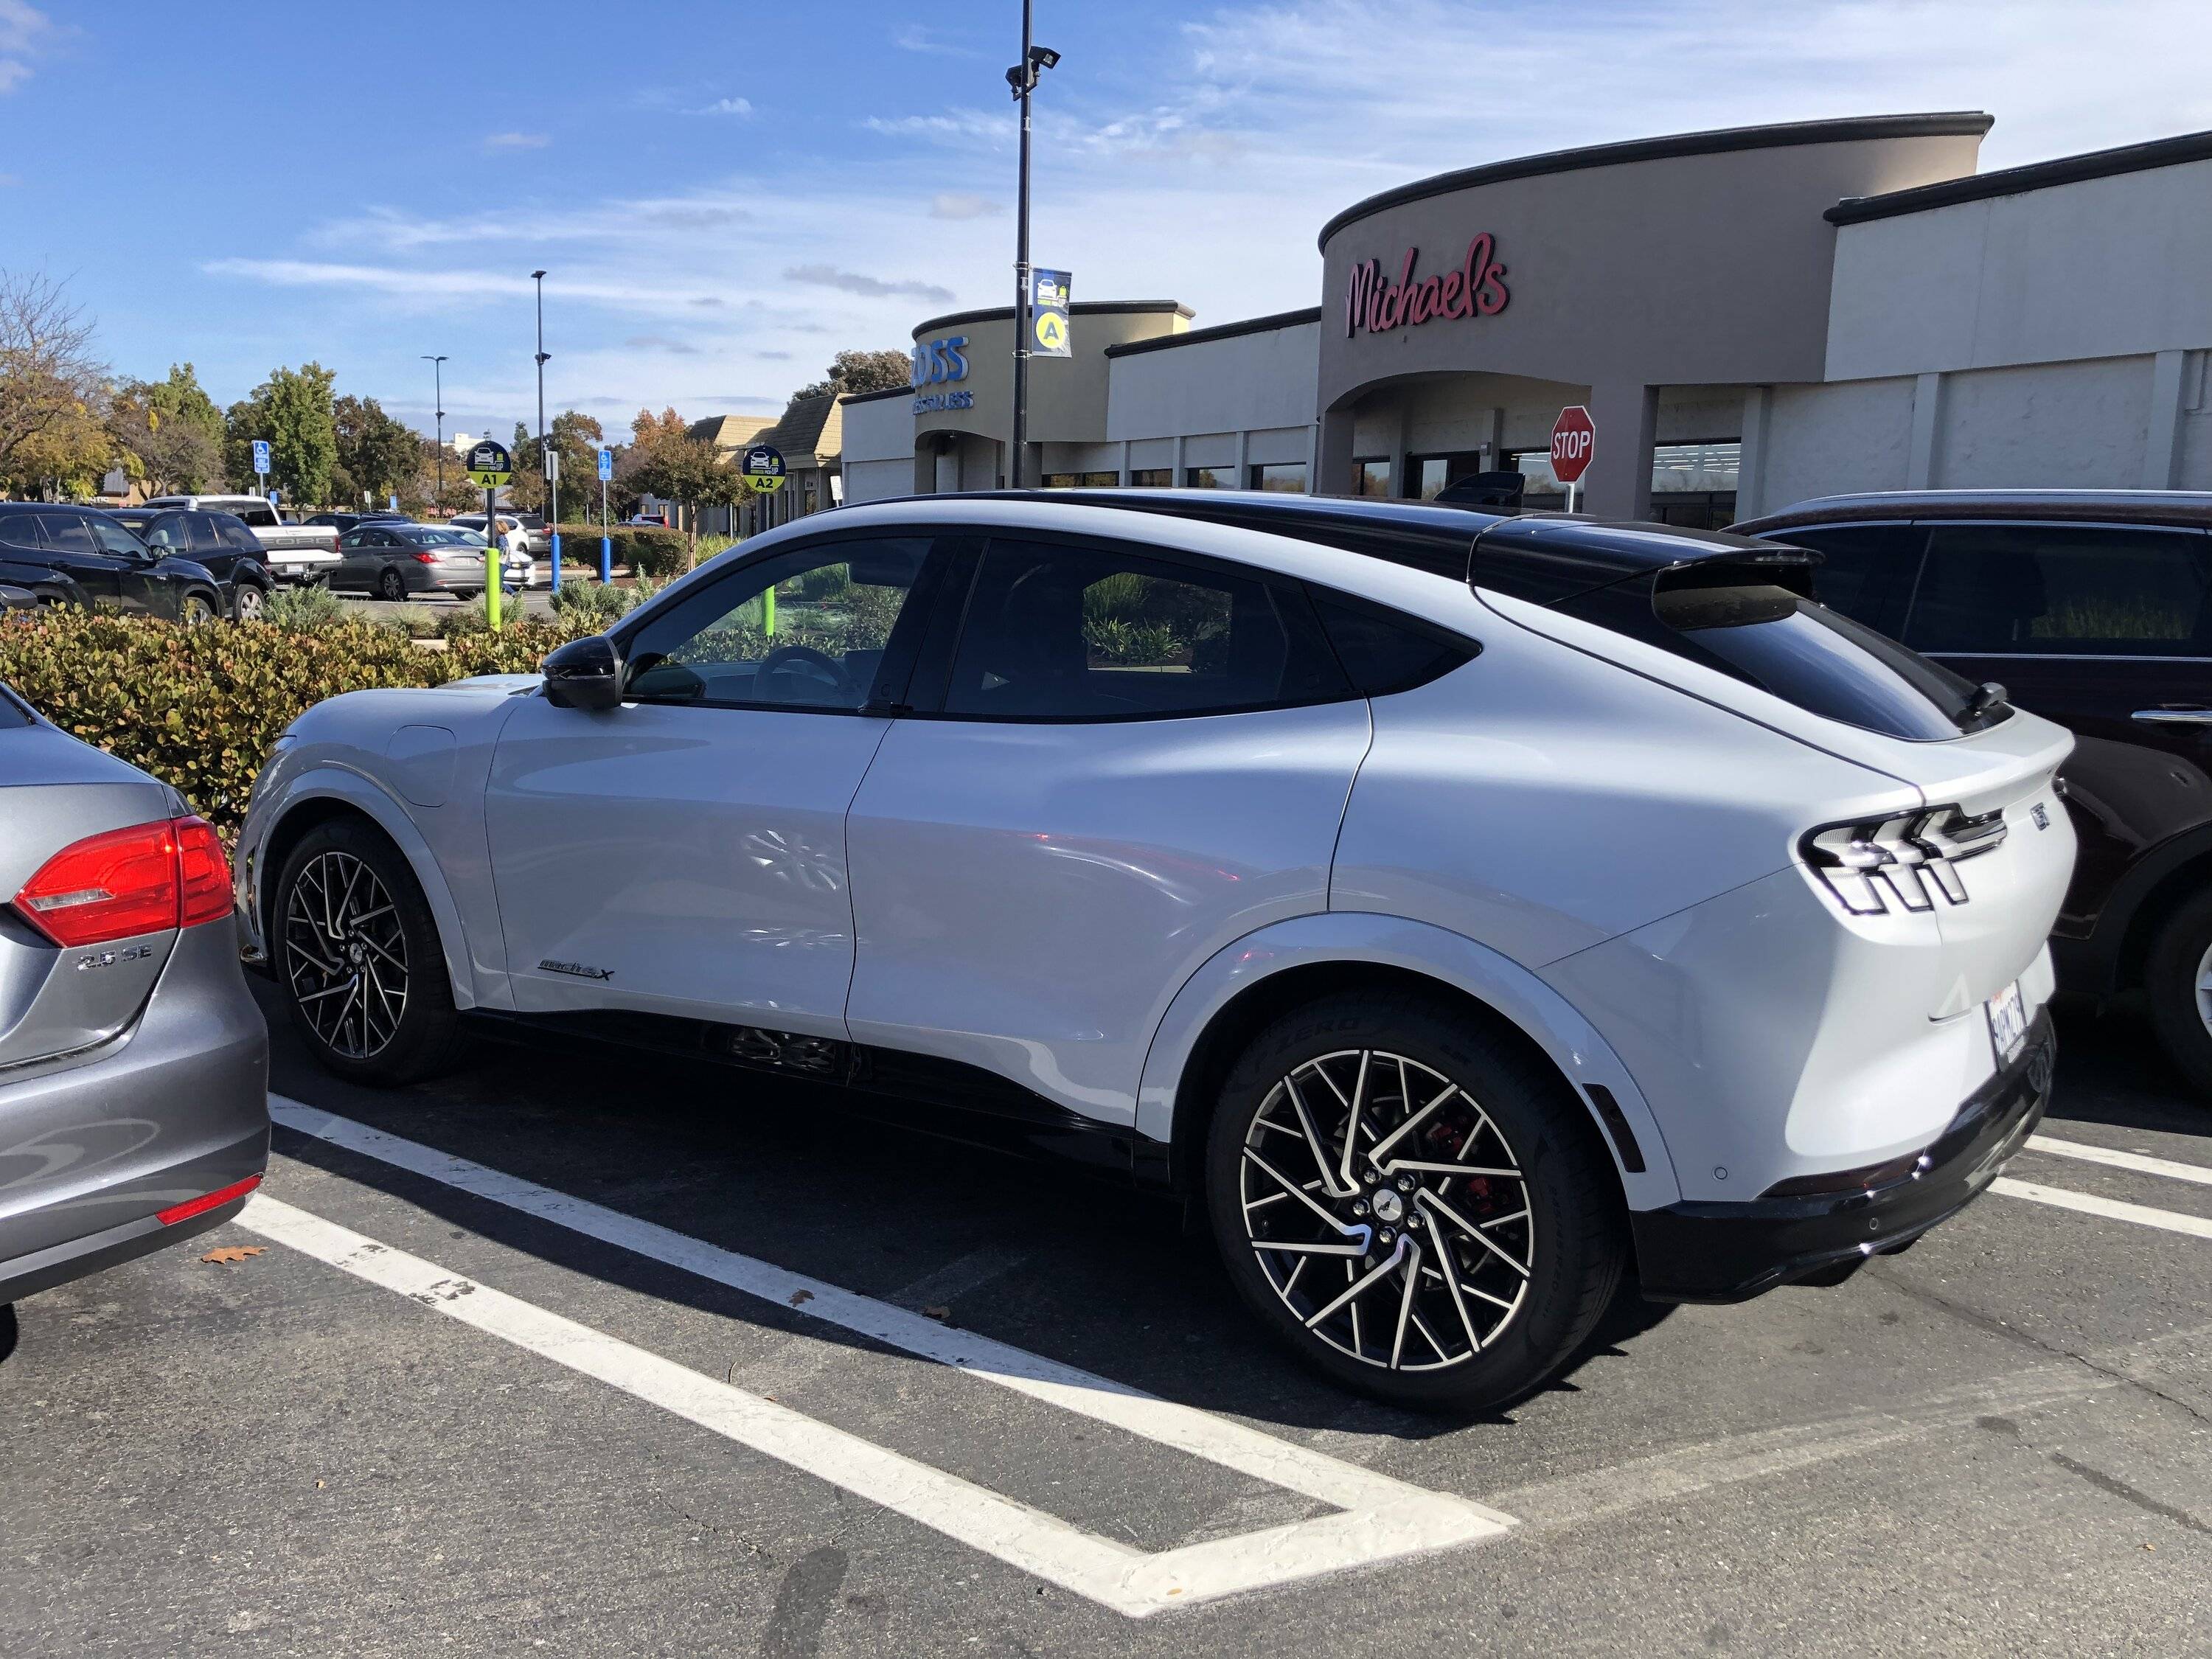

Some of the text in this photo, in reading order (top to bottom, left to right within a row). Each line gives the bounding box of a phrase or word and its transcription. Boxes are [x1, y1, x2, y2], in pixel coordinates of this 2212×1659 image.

[1346, 232, 1510, 338] Michaels
[1043, 321, 1059, 339] A
[1553, 431, 1591, 459] STOP
[481, 474, 497, 485] A1
[755, 477, 773, 489] A2
[122, 944, 153, 962] SE
